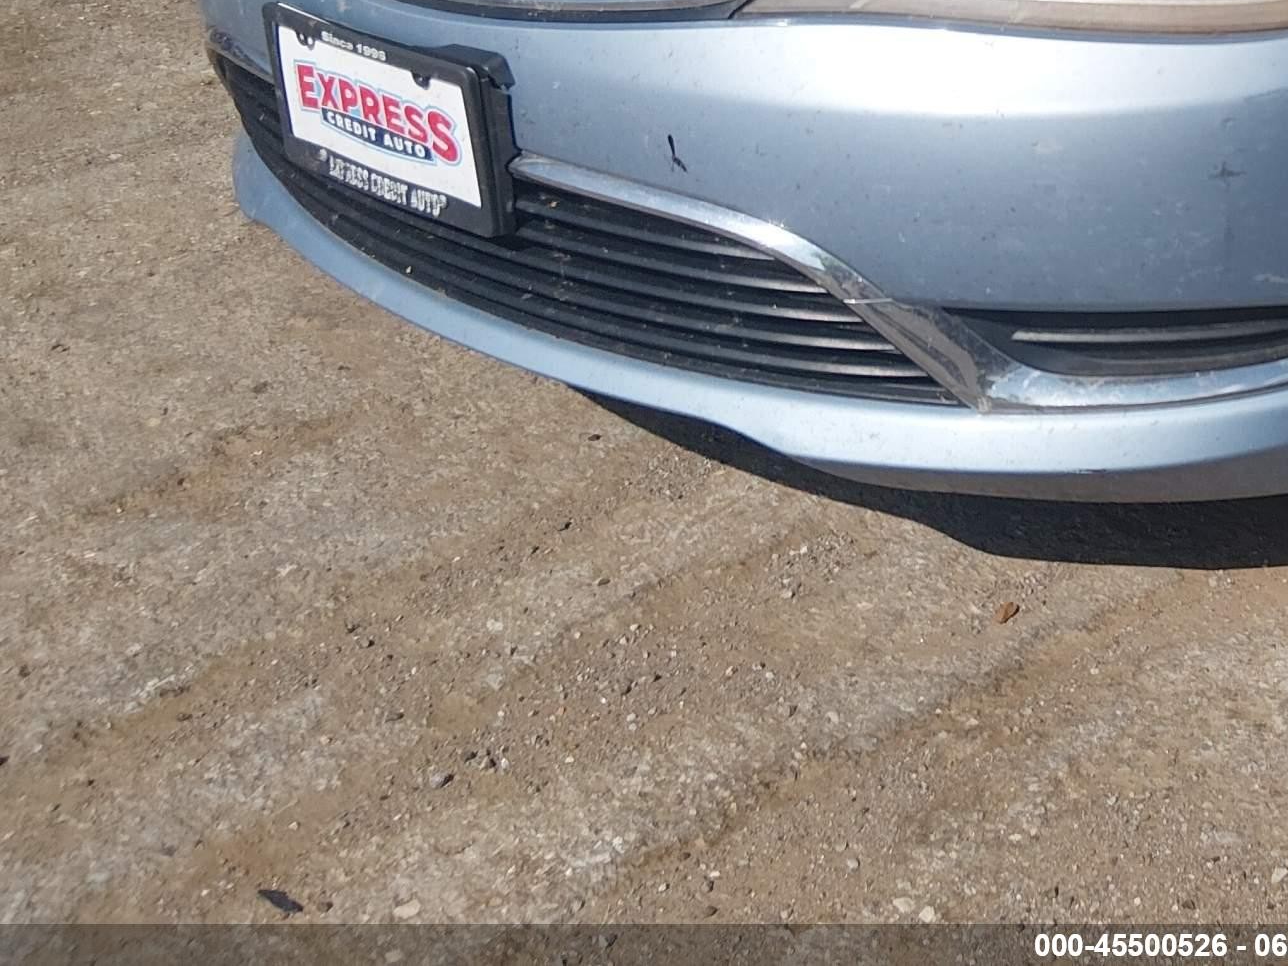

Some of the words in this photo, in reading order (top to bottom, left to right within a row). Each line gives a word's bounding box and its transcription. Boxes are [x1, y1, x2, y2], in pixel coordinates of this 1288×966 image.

[321, 31, 354, 51] Since
[295, 63, 458, 164] EXPRESS
[326, 111, 377, 142] CREDIT
[383, 134, 426, 158] AUTO
